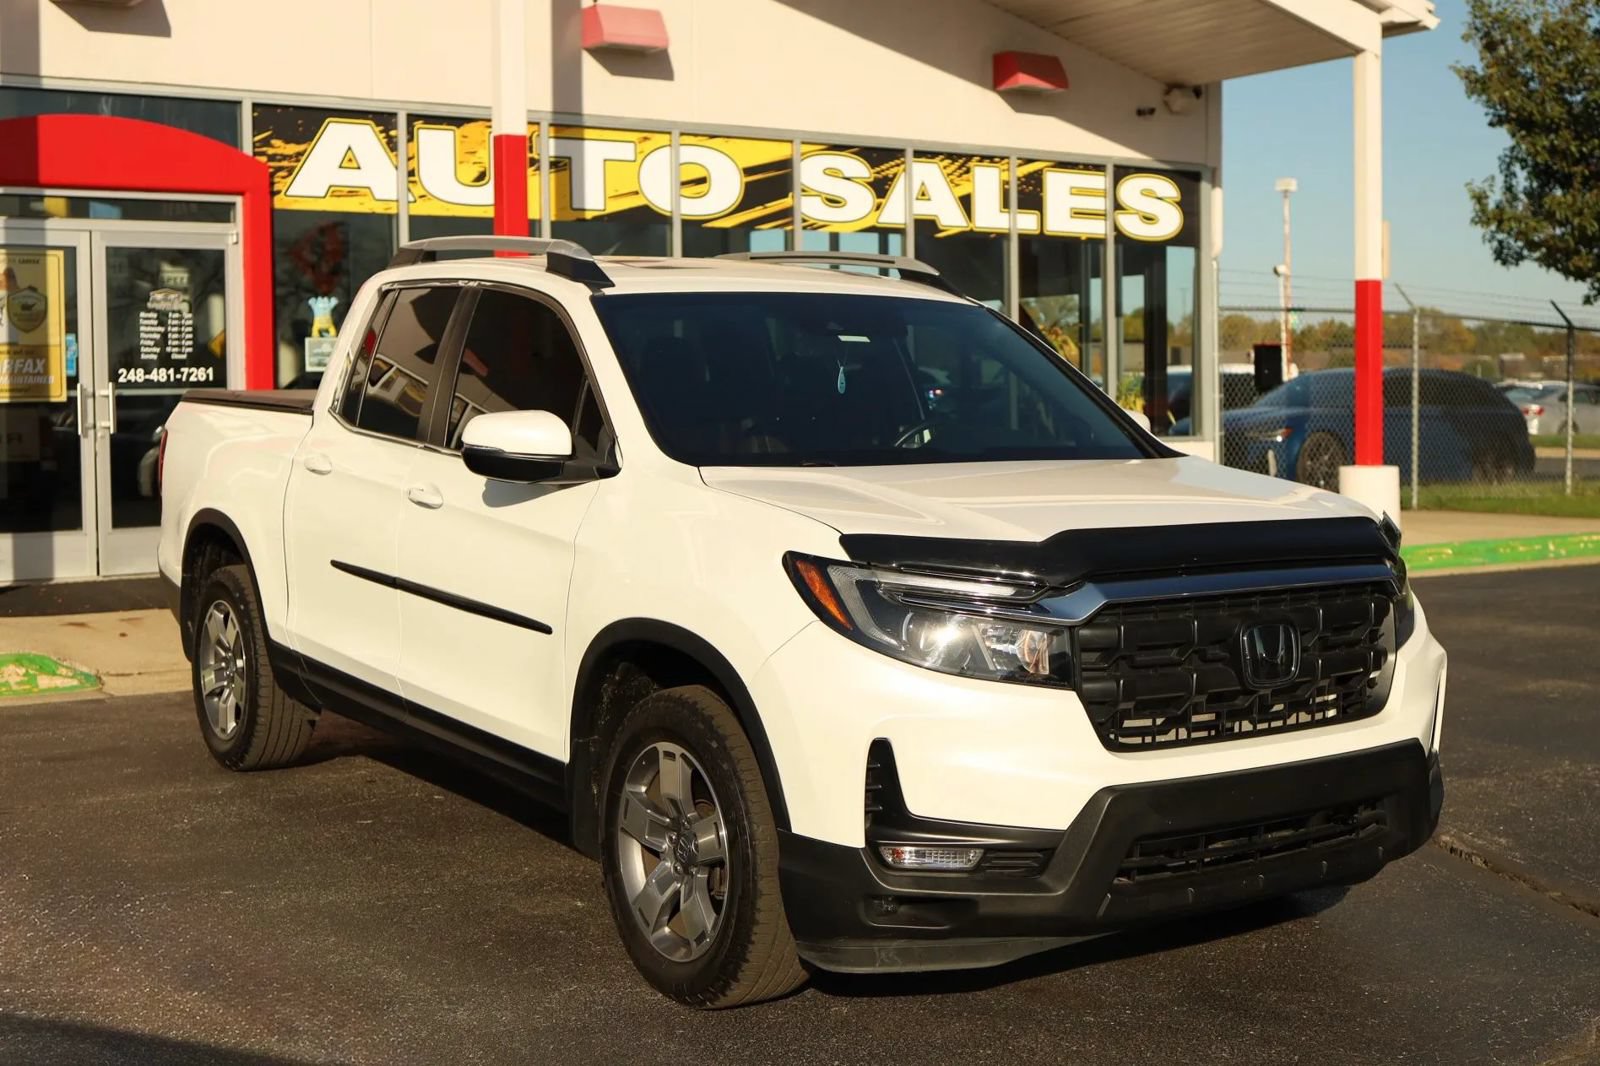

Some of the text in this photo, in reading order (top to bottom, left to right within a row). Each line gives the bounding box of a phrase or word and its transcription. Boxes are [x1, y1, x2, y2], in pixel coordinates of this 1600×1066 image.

[283, 120, 1184, 240] AUTO SALES
[1, 358, 46, 374] RFAX
[118, 367, 214, 383] 248-481-7261
